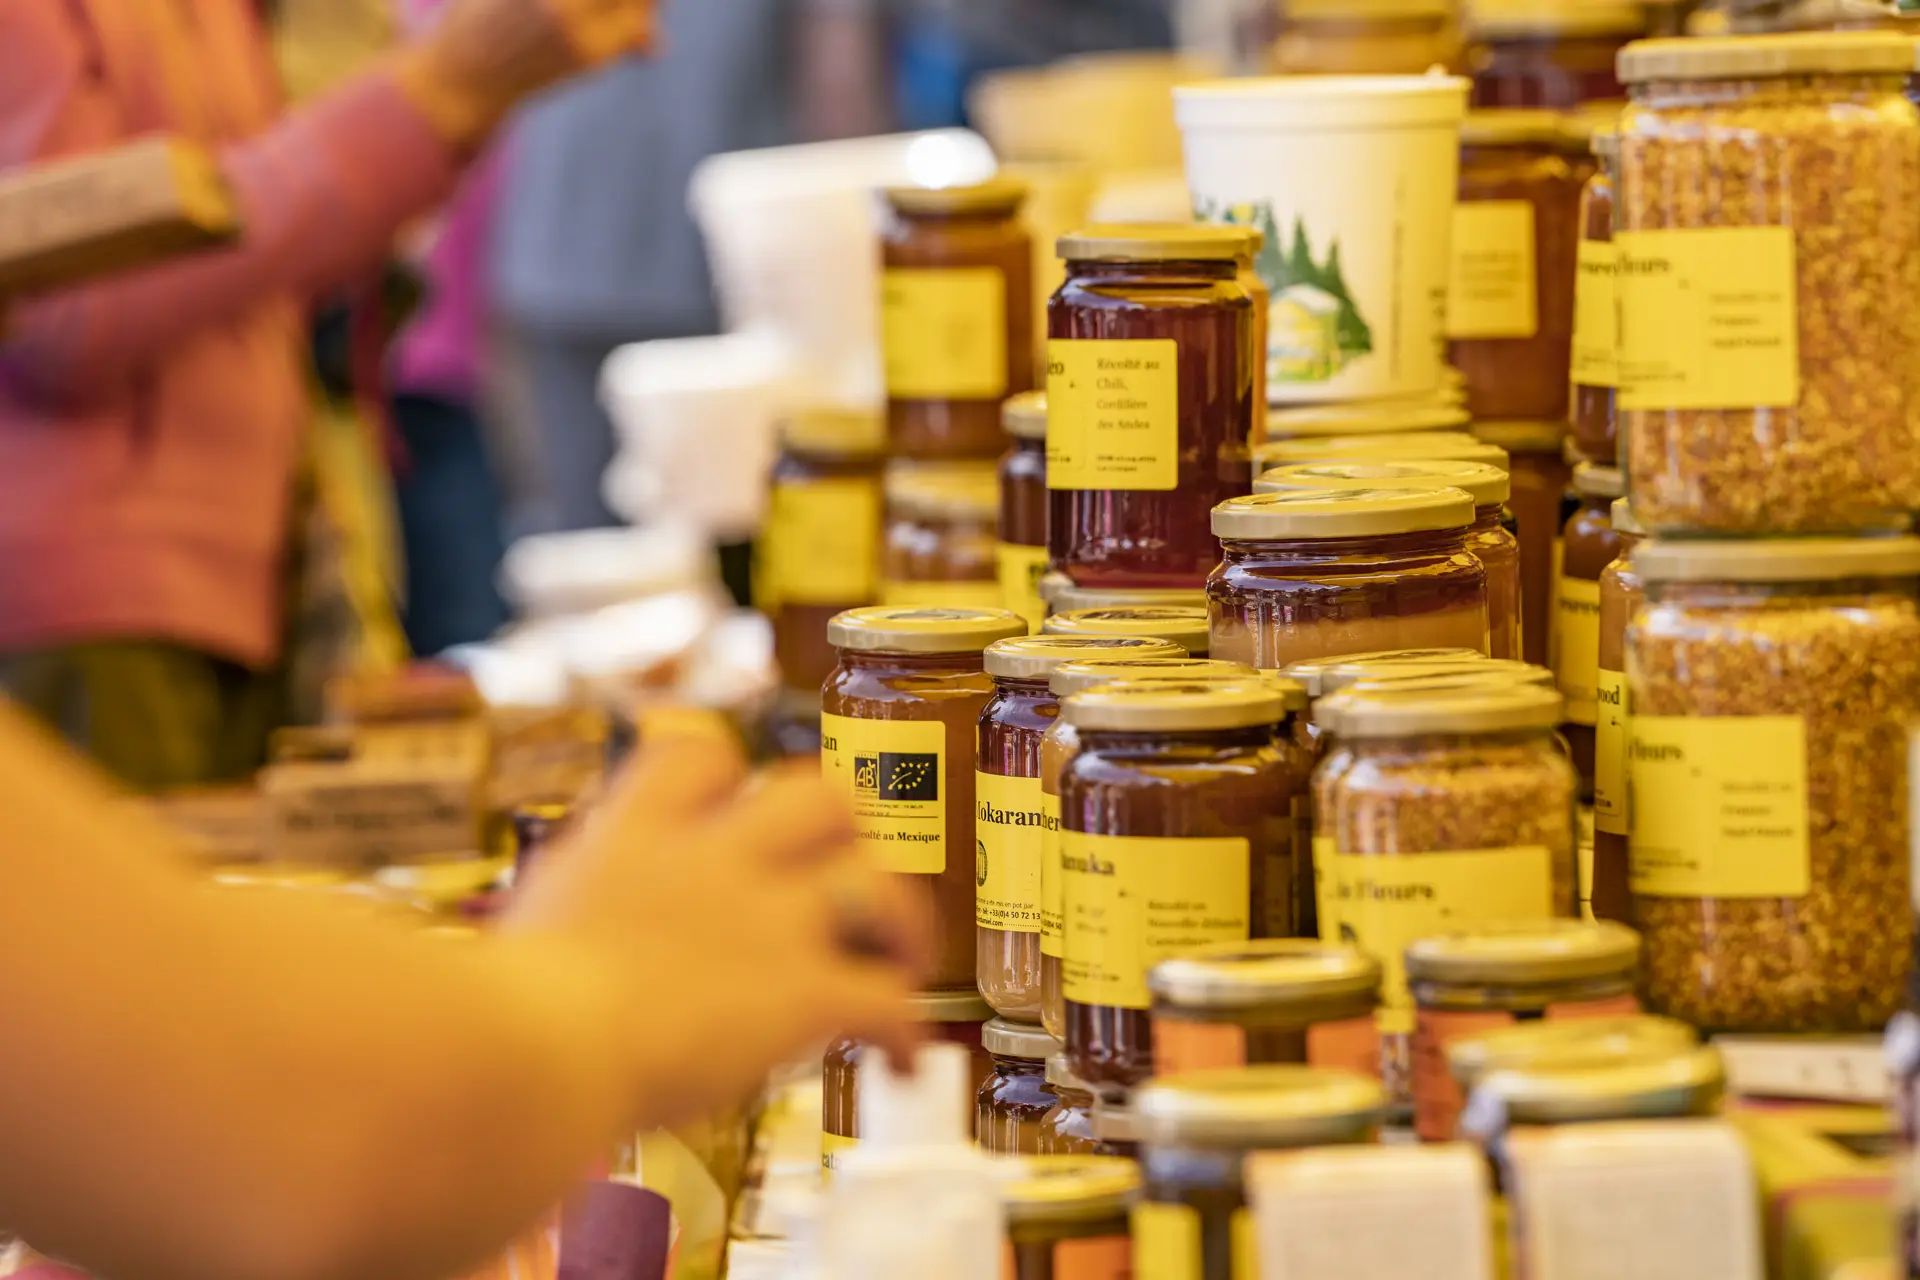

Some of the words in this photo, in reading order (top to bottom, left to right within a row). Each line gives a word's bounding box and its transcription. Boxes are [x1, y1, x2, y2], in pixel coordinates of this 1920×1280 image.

[1144, 360, 1160, 370] au
[883, 833, 894, 841] au
[897, 831, 941, 844] Mexique
[1012, 902, 1022, 910] pot
[1024, 902, 1034, 910] par
[989, 908, 1009, 919] +33(0)4
[1011, 911, 1019, 919] 50
[1021, 912, 1029, 920] 72
[1032, 912, 1040, 920] 13
